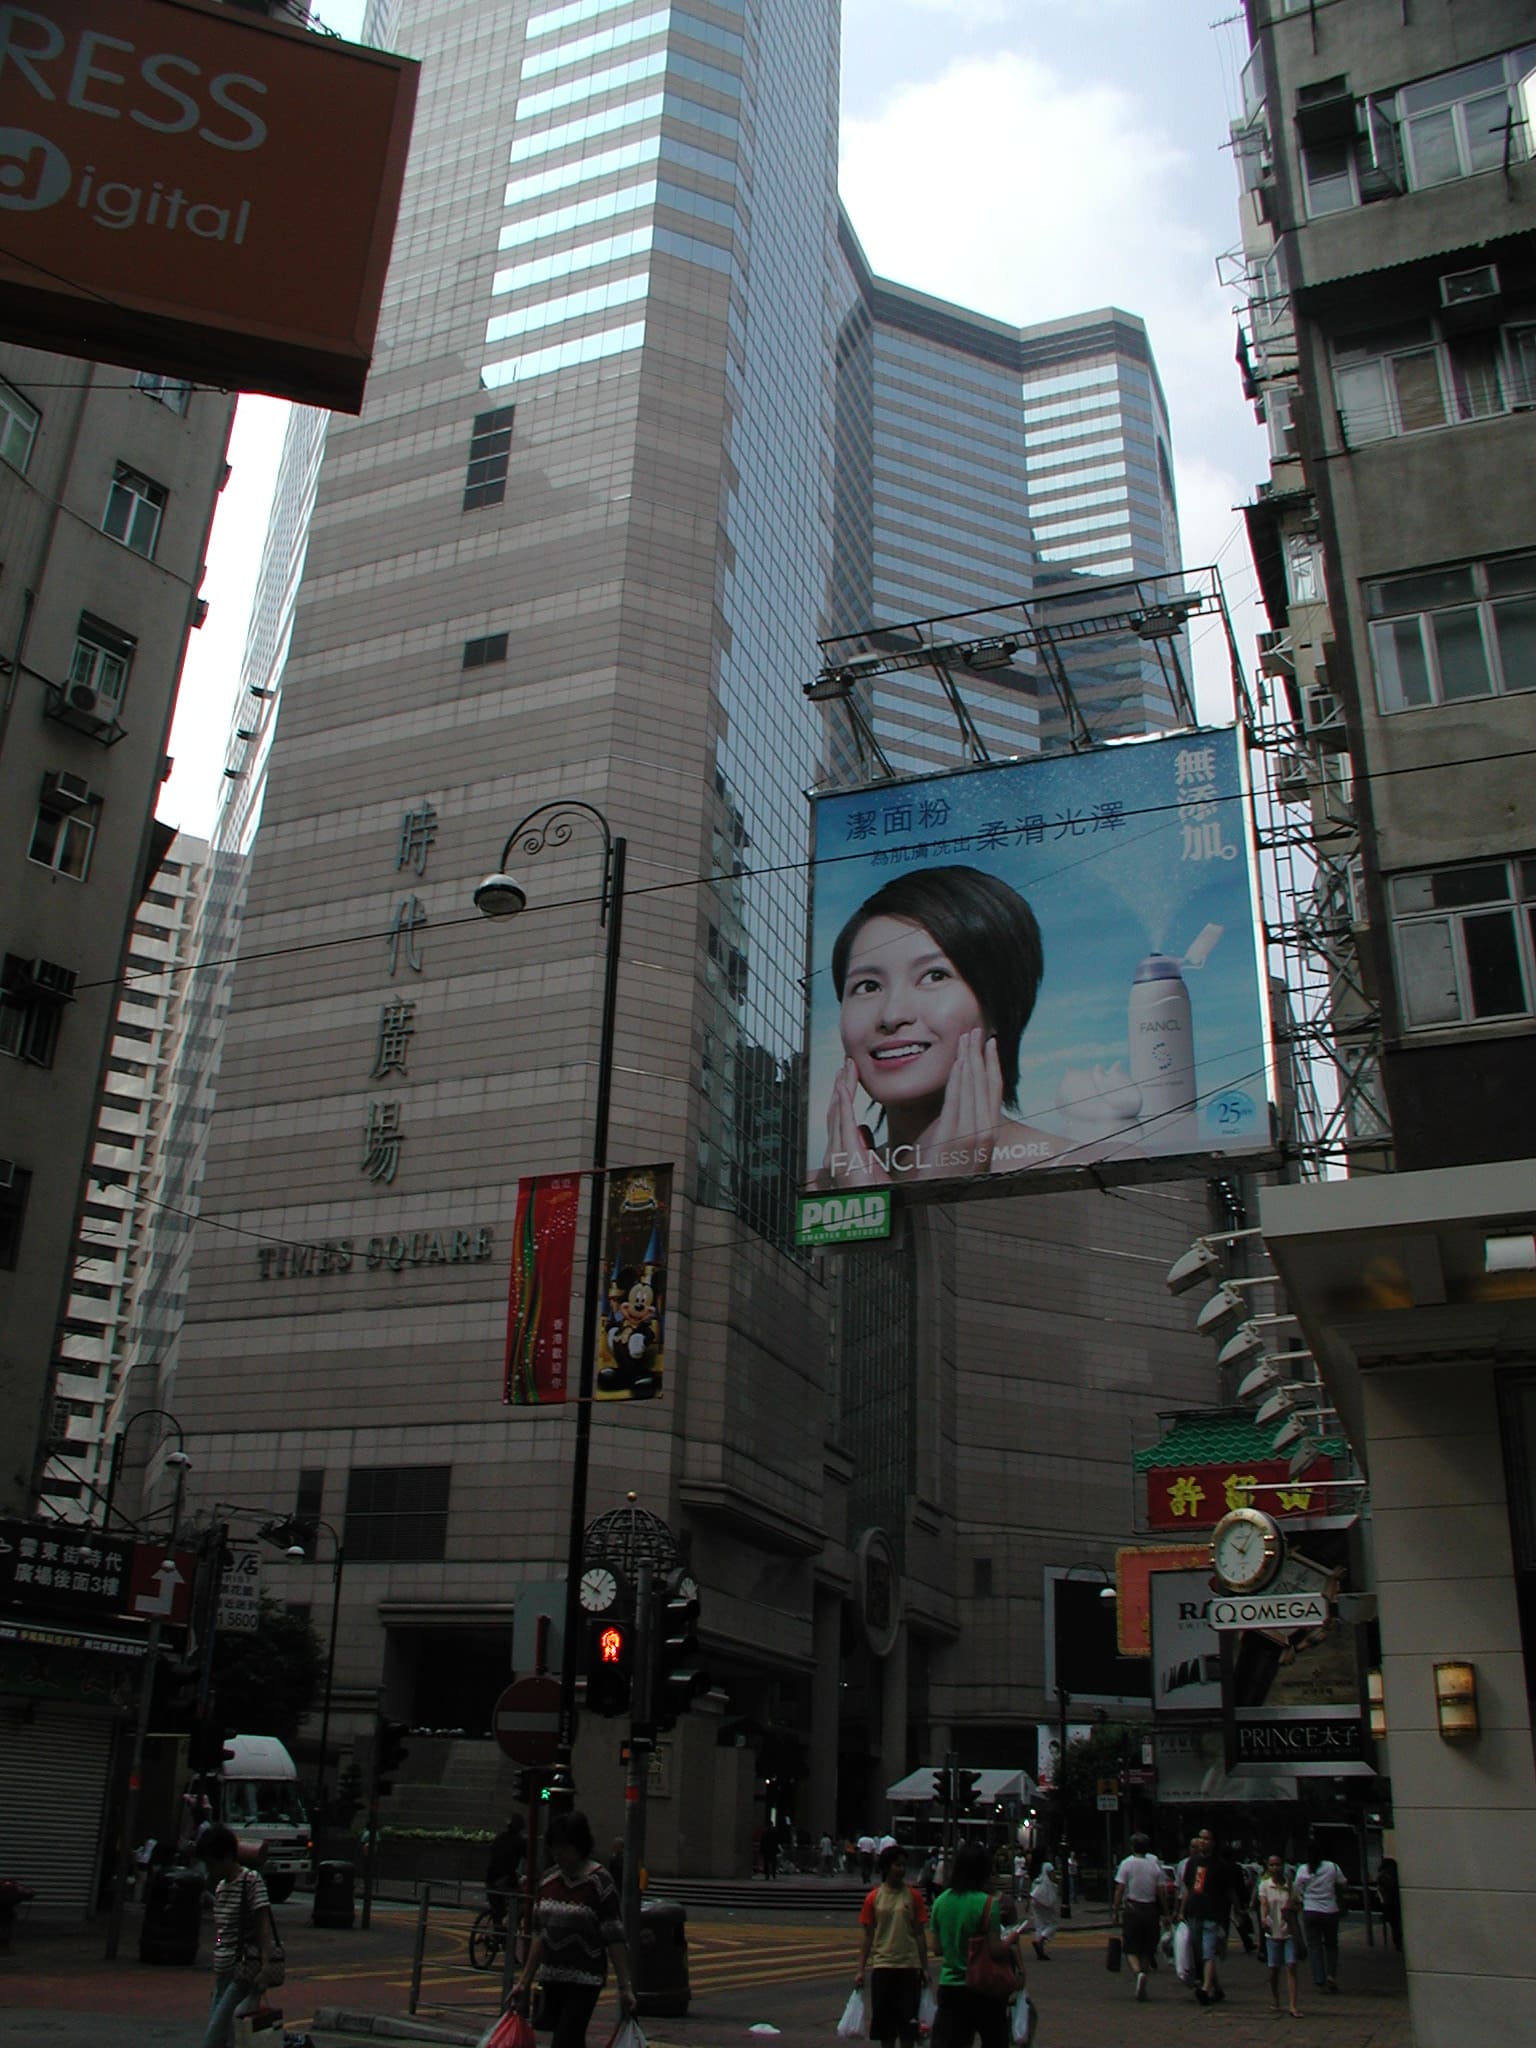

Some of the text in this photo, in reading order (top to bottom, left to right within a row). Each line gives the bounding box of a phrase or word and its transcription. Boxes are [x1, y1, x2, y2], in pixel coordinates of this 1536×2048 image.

[846, 798, 951, 841] 潔面粉
[359, 800, 438, 1186] 時代廣場
[1140, 1019, 1182, 1032] FANCL
[830, 1142, 1050, 1178] FANCL LESS IS MORE
[802, 1196, 885, 1233] POAD
[259, 1227, 494, 1279] TIMES SQUARE
[1241, 1601, 1322, 1620] OMEGA
[1240, 1725, 1360, 1748] PRINCE 太子
